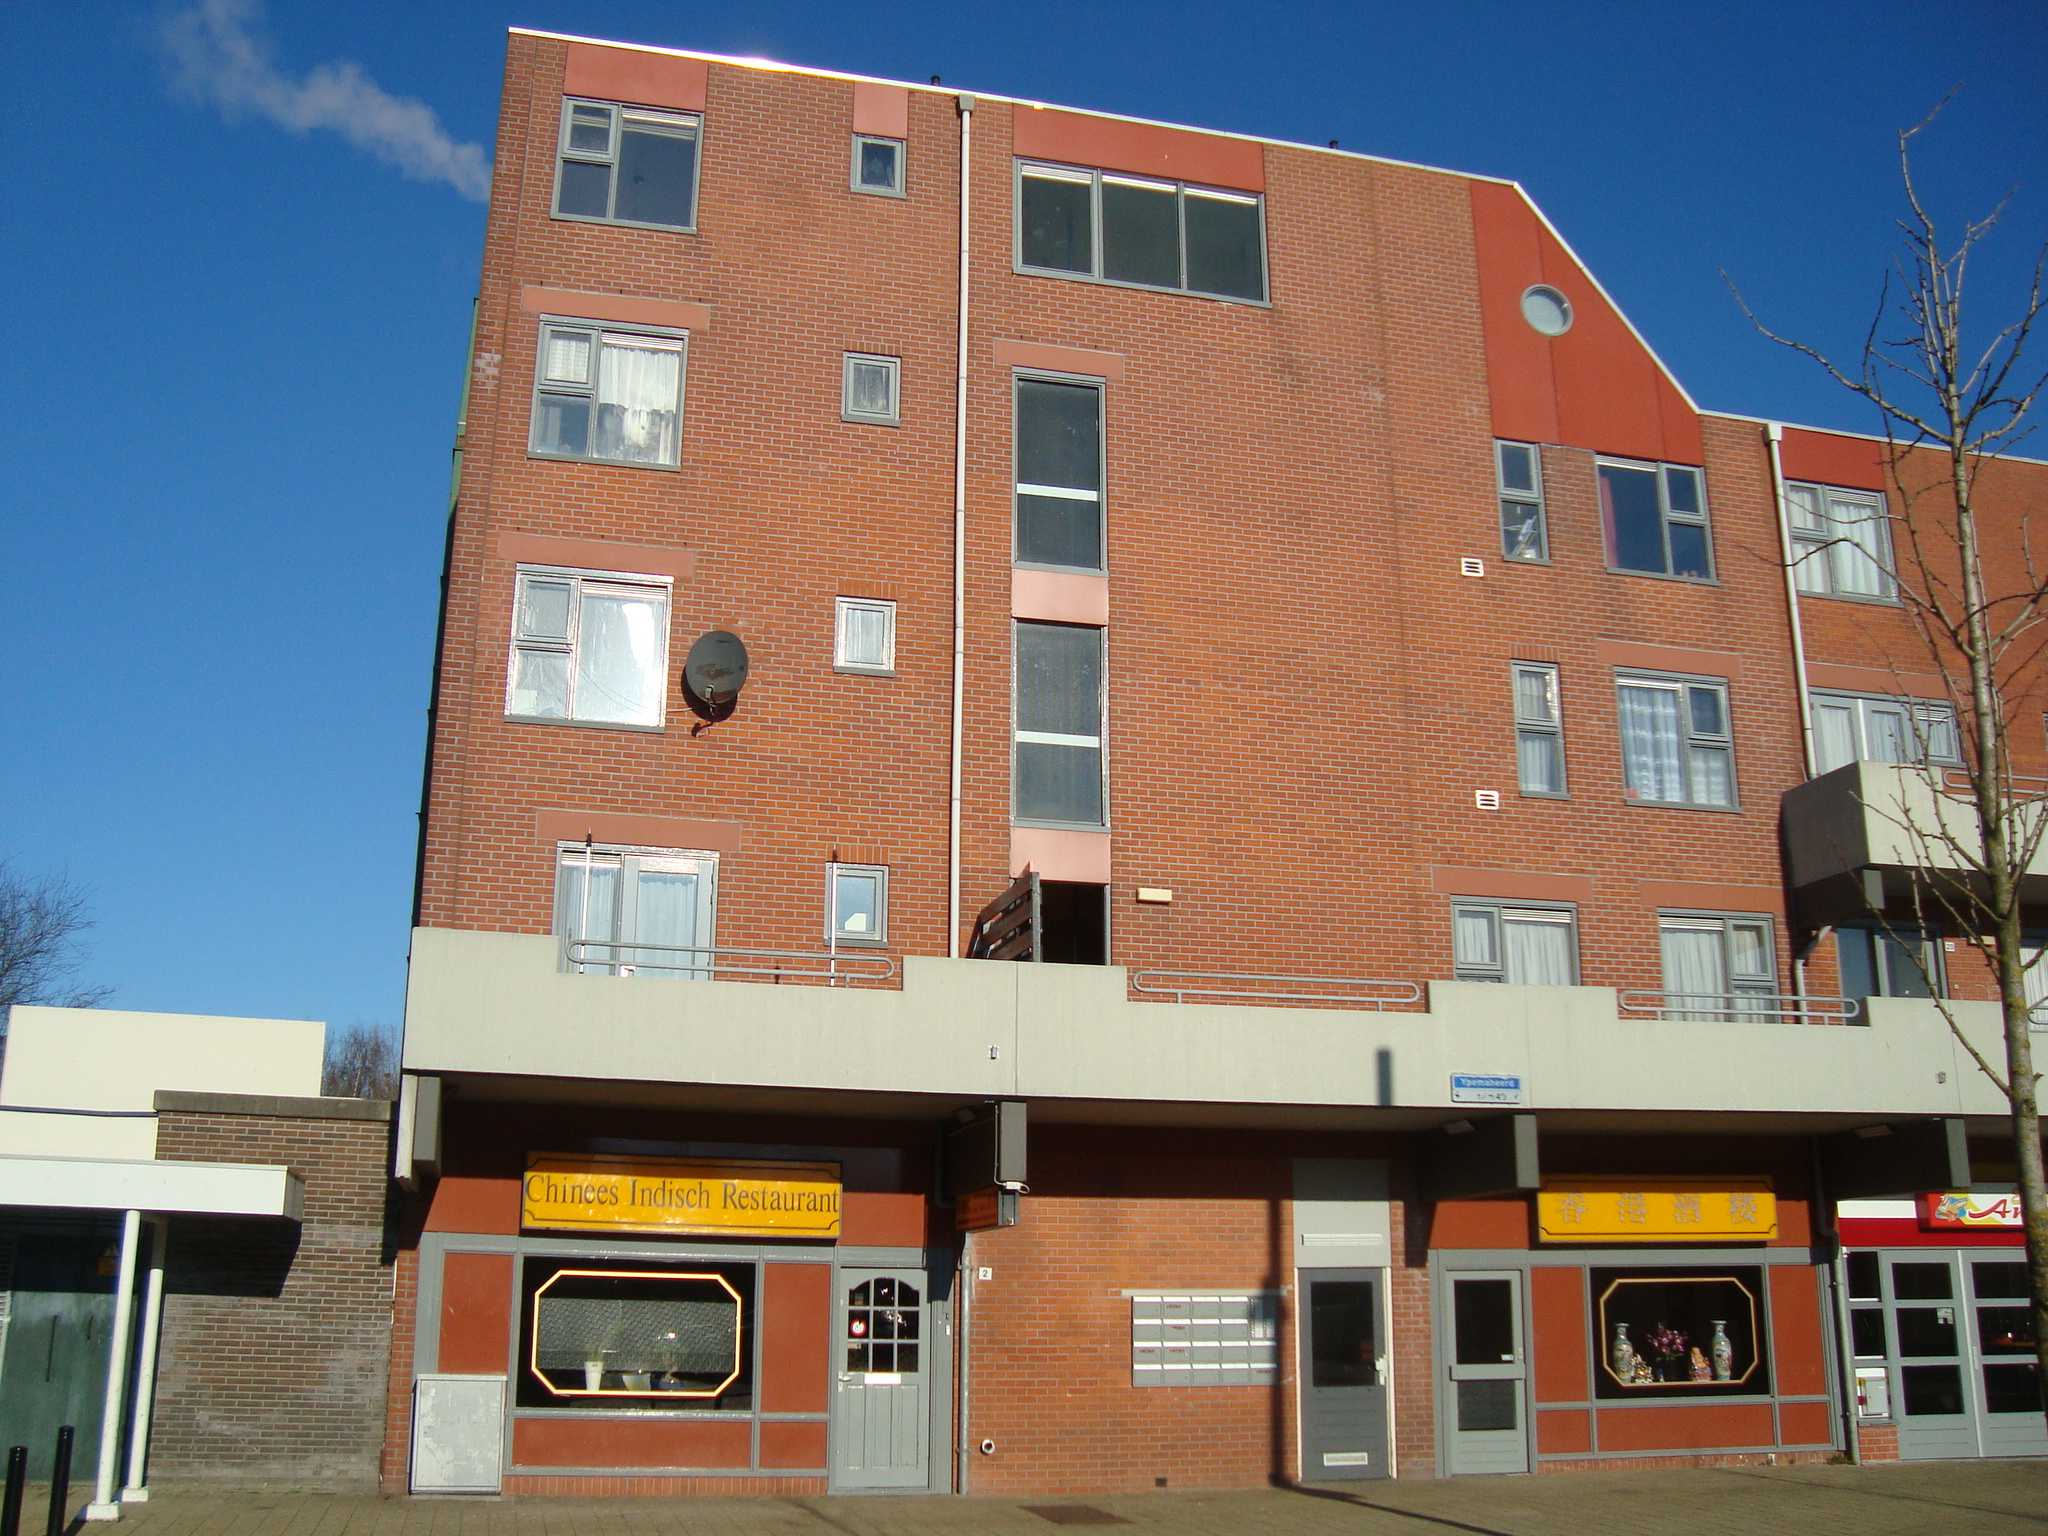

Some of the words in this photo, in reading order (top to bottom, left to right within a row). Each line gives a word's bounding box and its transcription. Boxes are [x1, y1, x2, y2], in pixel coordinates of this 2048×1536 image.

[525, 1174, 619, 1206] Chinees
[629, 1179, 710, 1209] Indisch
[722, 1183, 839, 1213] Restaurant
[981, 1269, 989, 1278] 2
